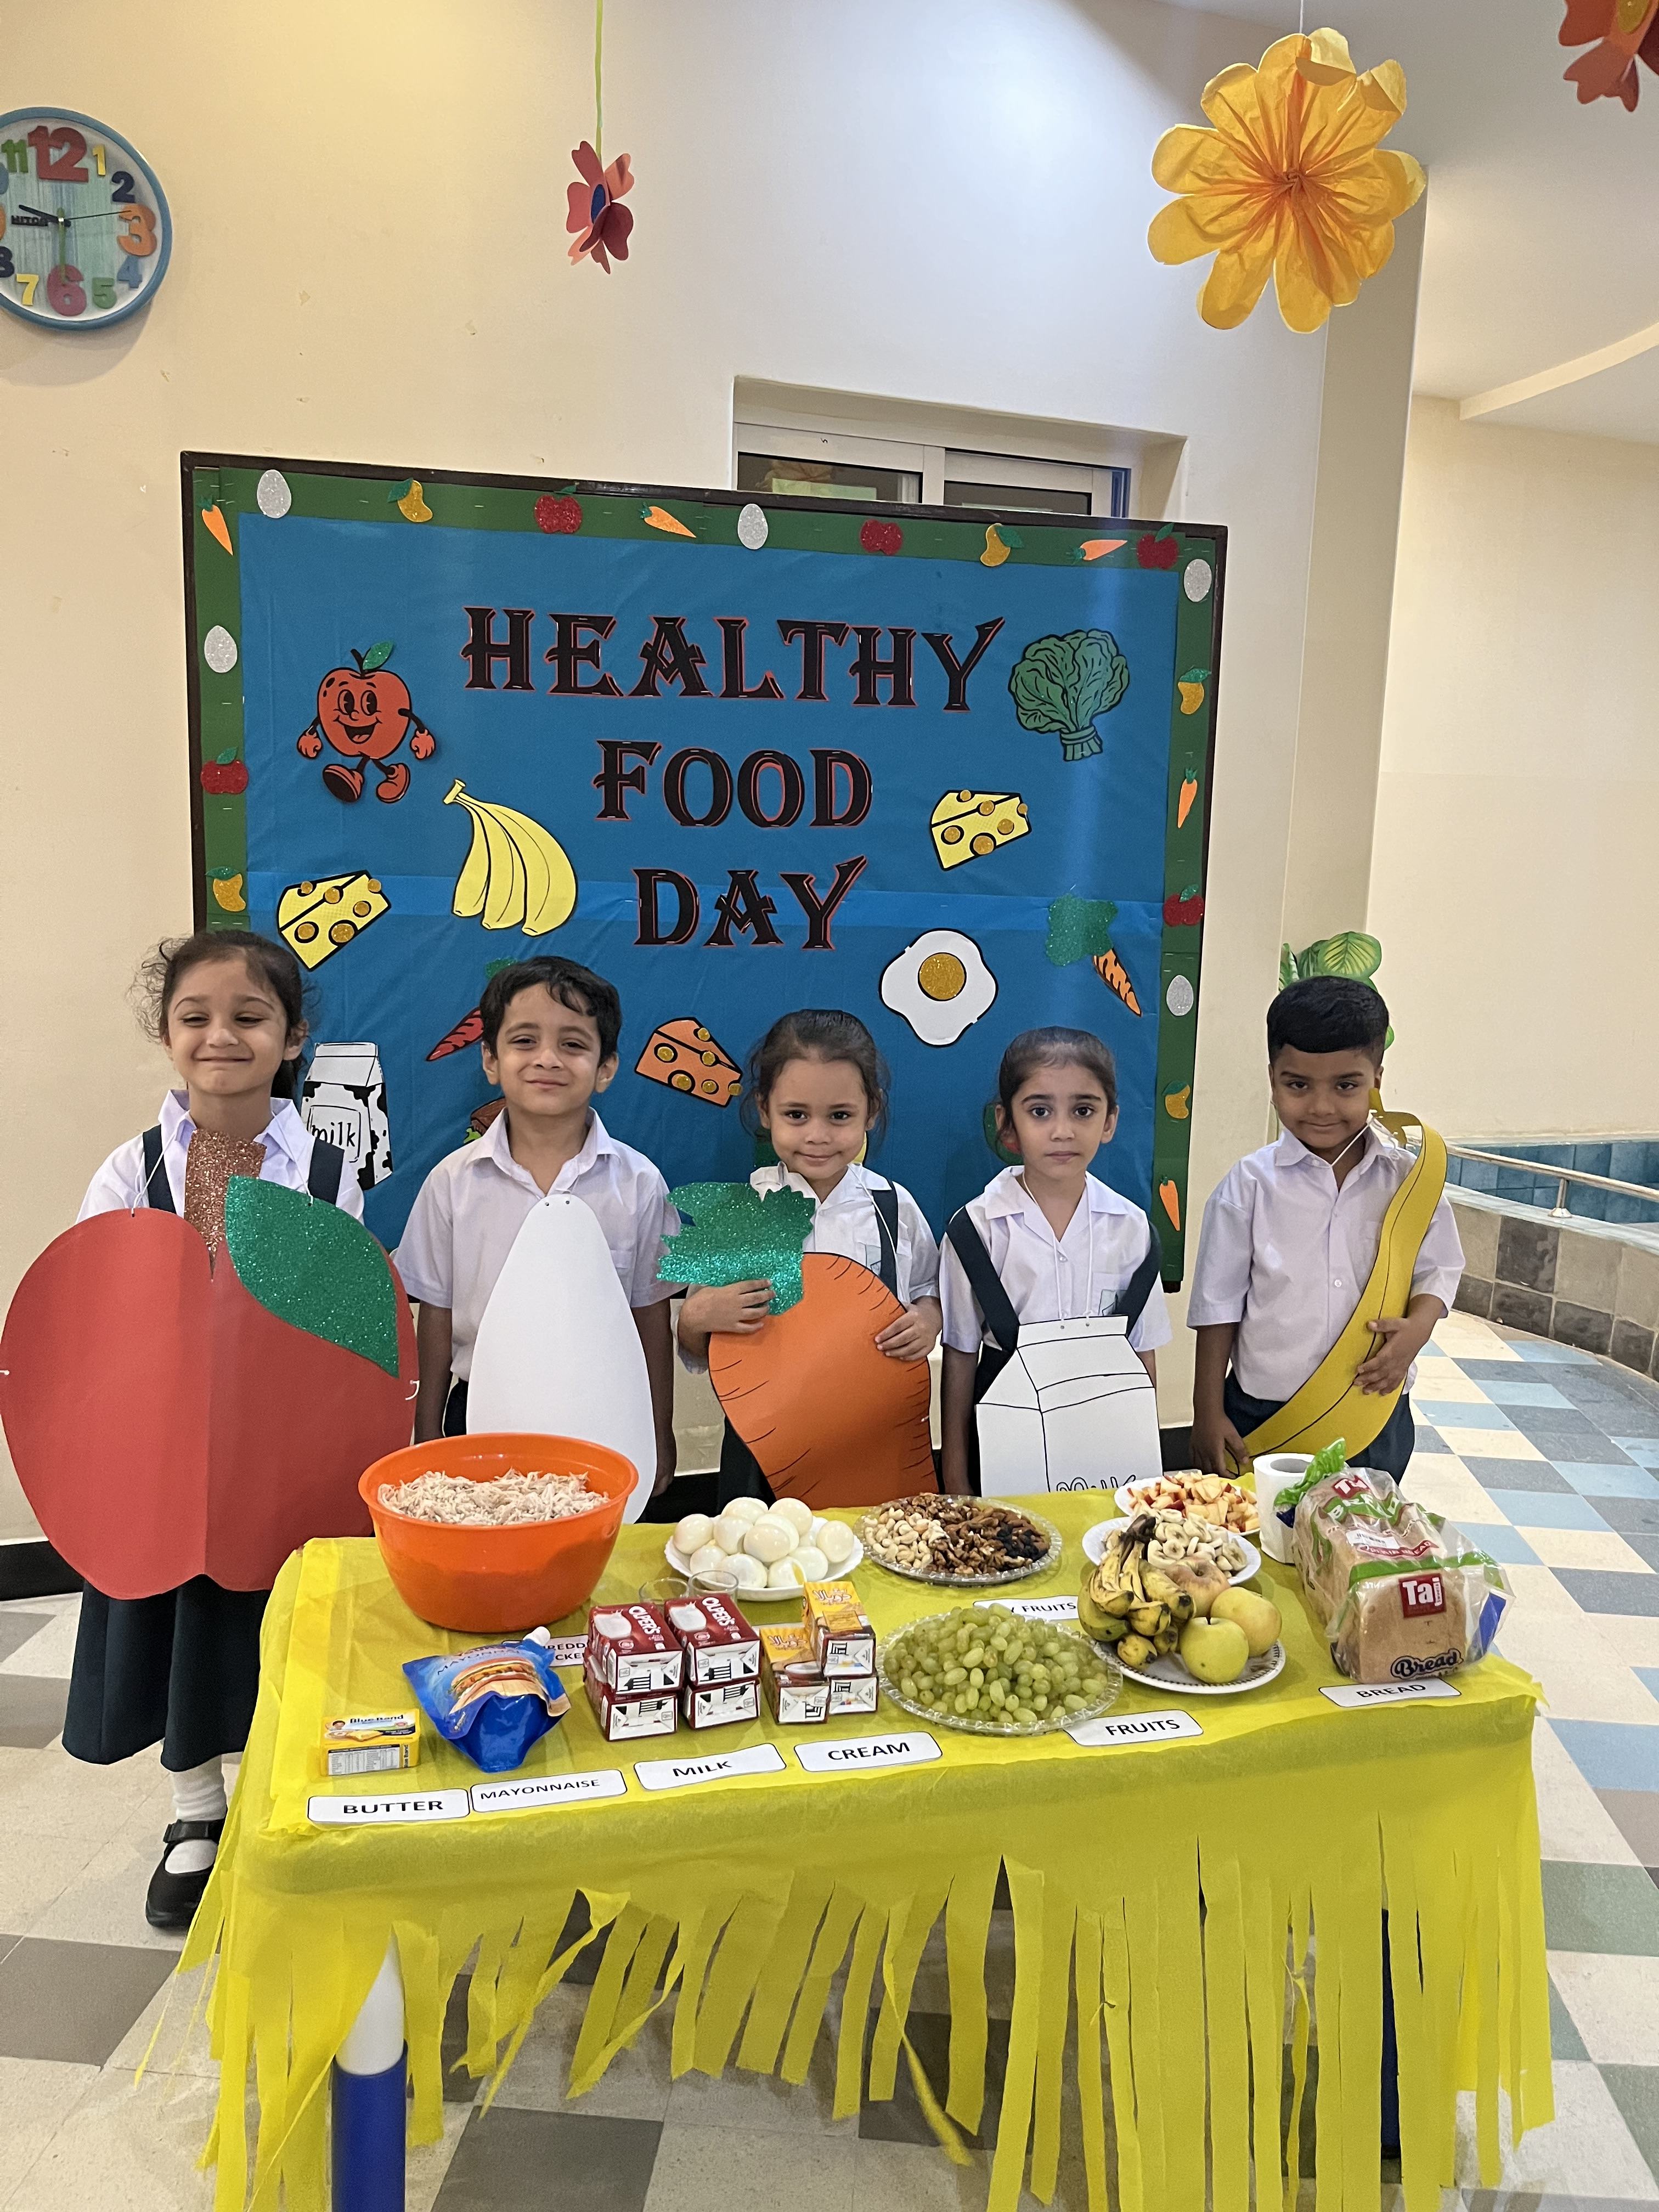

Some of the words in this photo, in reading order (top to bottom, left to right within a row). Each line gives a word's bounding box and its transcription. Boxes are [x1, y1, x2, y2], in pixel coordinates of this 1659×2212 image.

[1, 139, 29, 173] 11
[27, 126, 89, 183] 12
[92, 144, 106, 176] 1
[111, 171, 136, 203] 2
[117, 204, 157, 256] 3
[117, 255, 143, 289] 4
[16, 273, 40, 306] 7
[47, 264, 87, 317] 6
[92, 277, 117, 309] 5
[461, 606, 1005, 712] HEALTHY
[593, 739, 873, 828] FOOD
[633, 855, 868, 951] DAY
[312, 1121, 356, 1148] milk
[1402, 1577, 1443, 1606] Taj
[1022, 1602, 1076, 1612] FRUITS
[544, 1643, 588, 1651] REDD
[555, 1652, 585, 1661] CKE
[1394, 1651, 1458, 1677] Bread
[1356, 1684, 1426, 1699] BREAD
[1105, 1719, 1181, 1736] FRUITS
[827, 1741, 911, 1762] CREAM
[673, 1759, 733, 1778] MILK
[481, 1778, 601, 1800] MAYONNAISE
[343, 1800, 444, 1814] BUTTER
